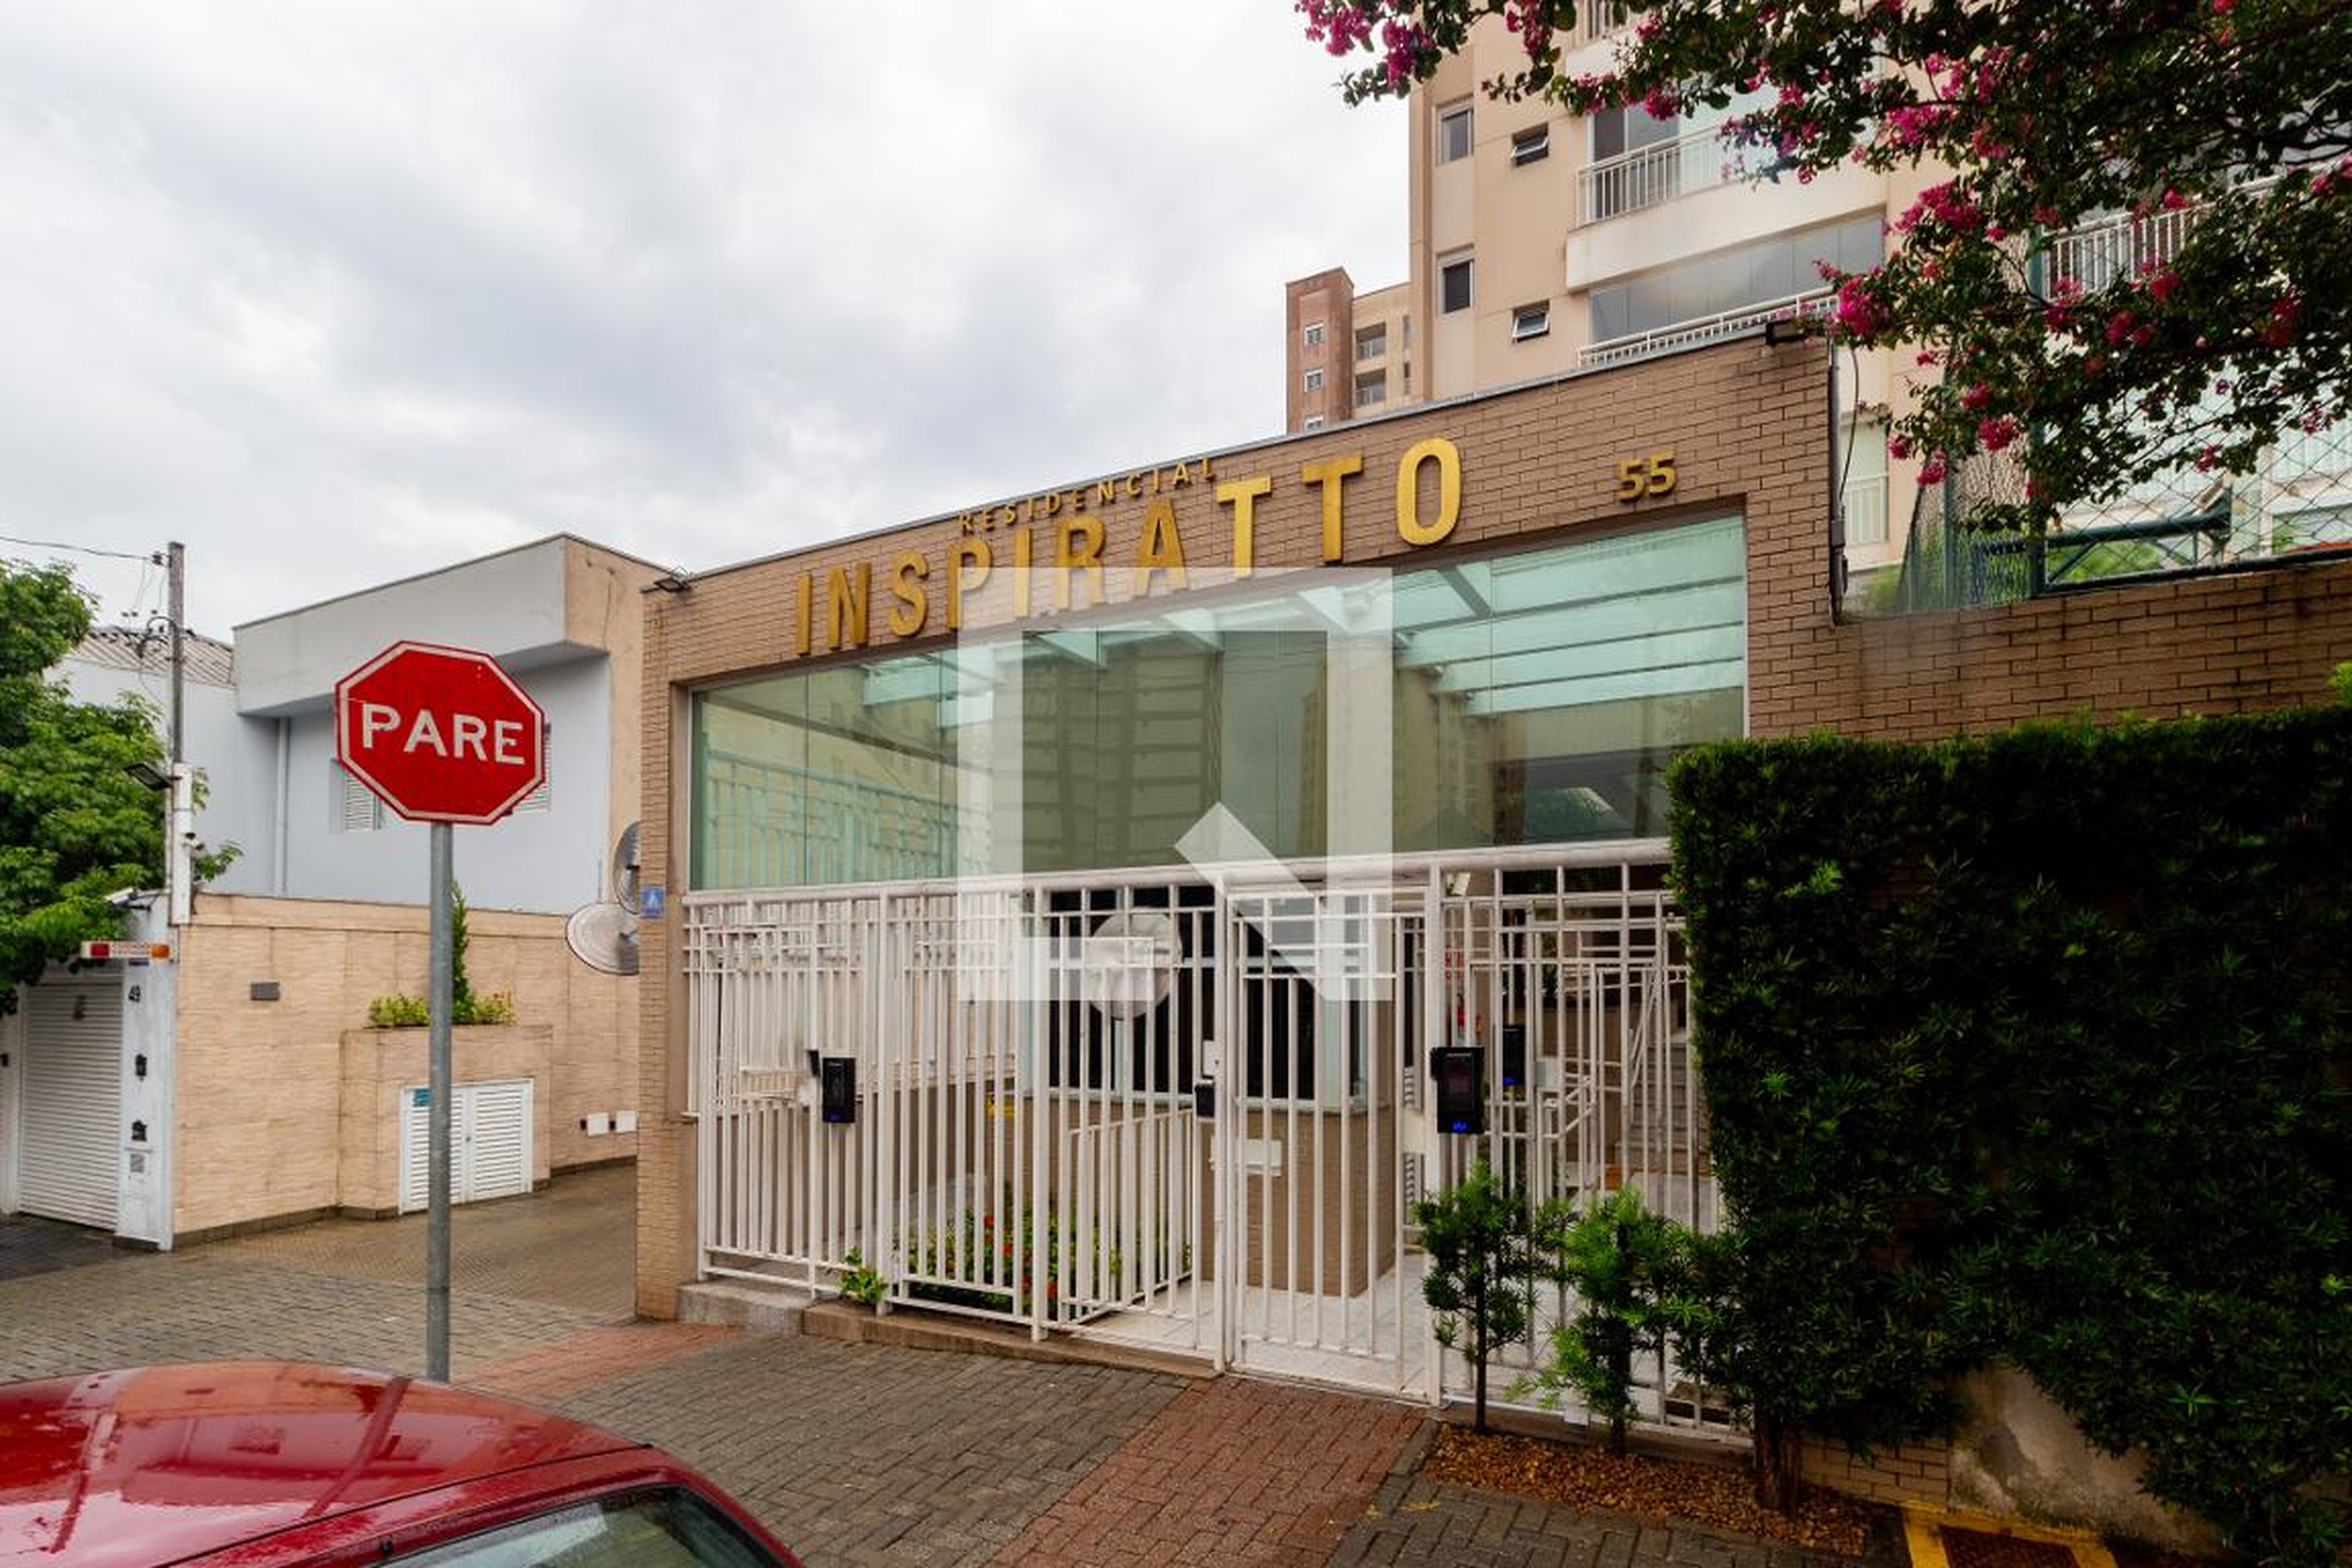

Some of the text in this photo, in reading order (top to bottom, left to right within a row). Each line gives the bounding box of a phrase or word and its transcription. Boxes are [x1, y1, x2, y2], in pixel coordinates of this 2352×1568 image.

[957, 456, 1215, 535] RESIDENCIAL
[1618, 450, 1676, 500] 55
[796, 437, 1463, 656] INSPIRATTO
[363, 703, 525, 765] PARE
